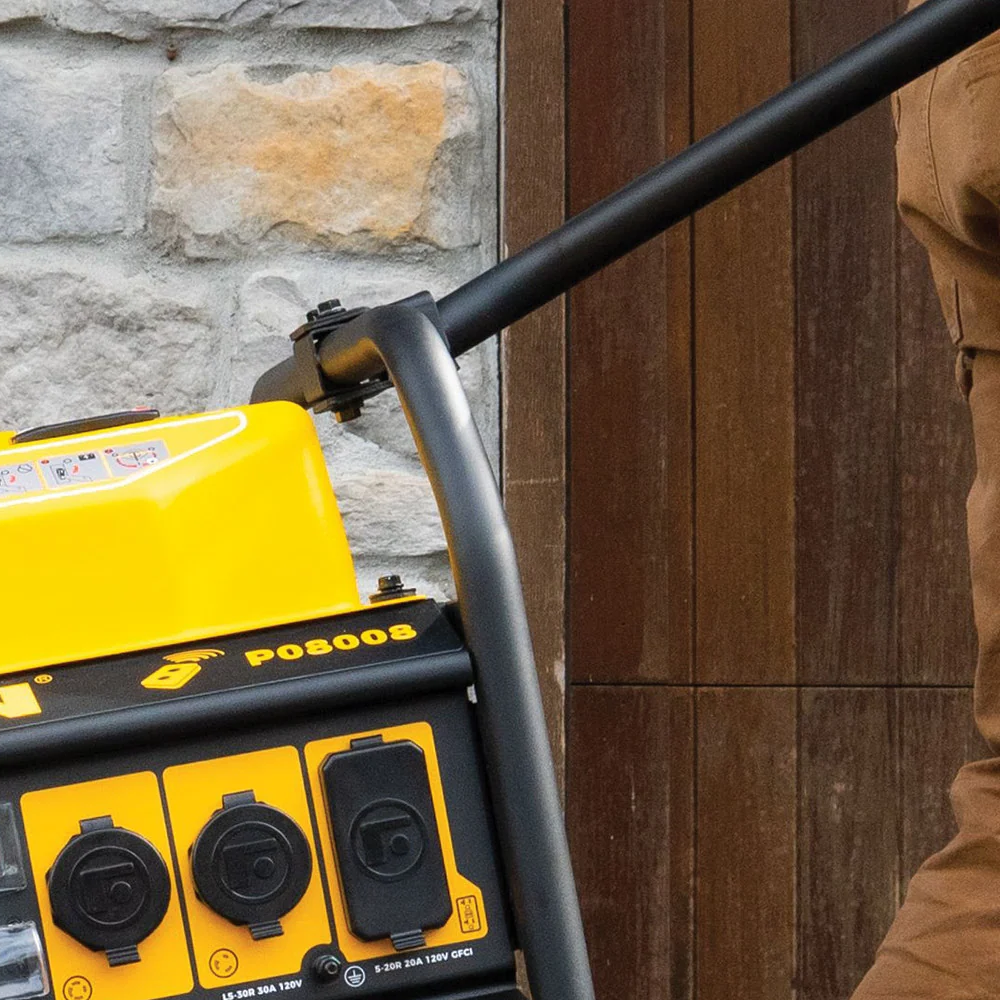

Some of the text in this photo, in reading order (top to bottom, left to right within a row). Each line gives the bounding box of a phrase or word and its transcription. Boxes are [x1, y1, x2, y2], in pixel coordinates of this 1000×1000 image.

[244, 624, 417, 667] P08008
[375, 947, 473, 973] 5-20R 20A 120V GFCI
[222, 979, 302, 1000] L5-30R 30A 120V
